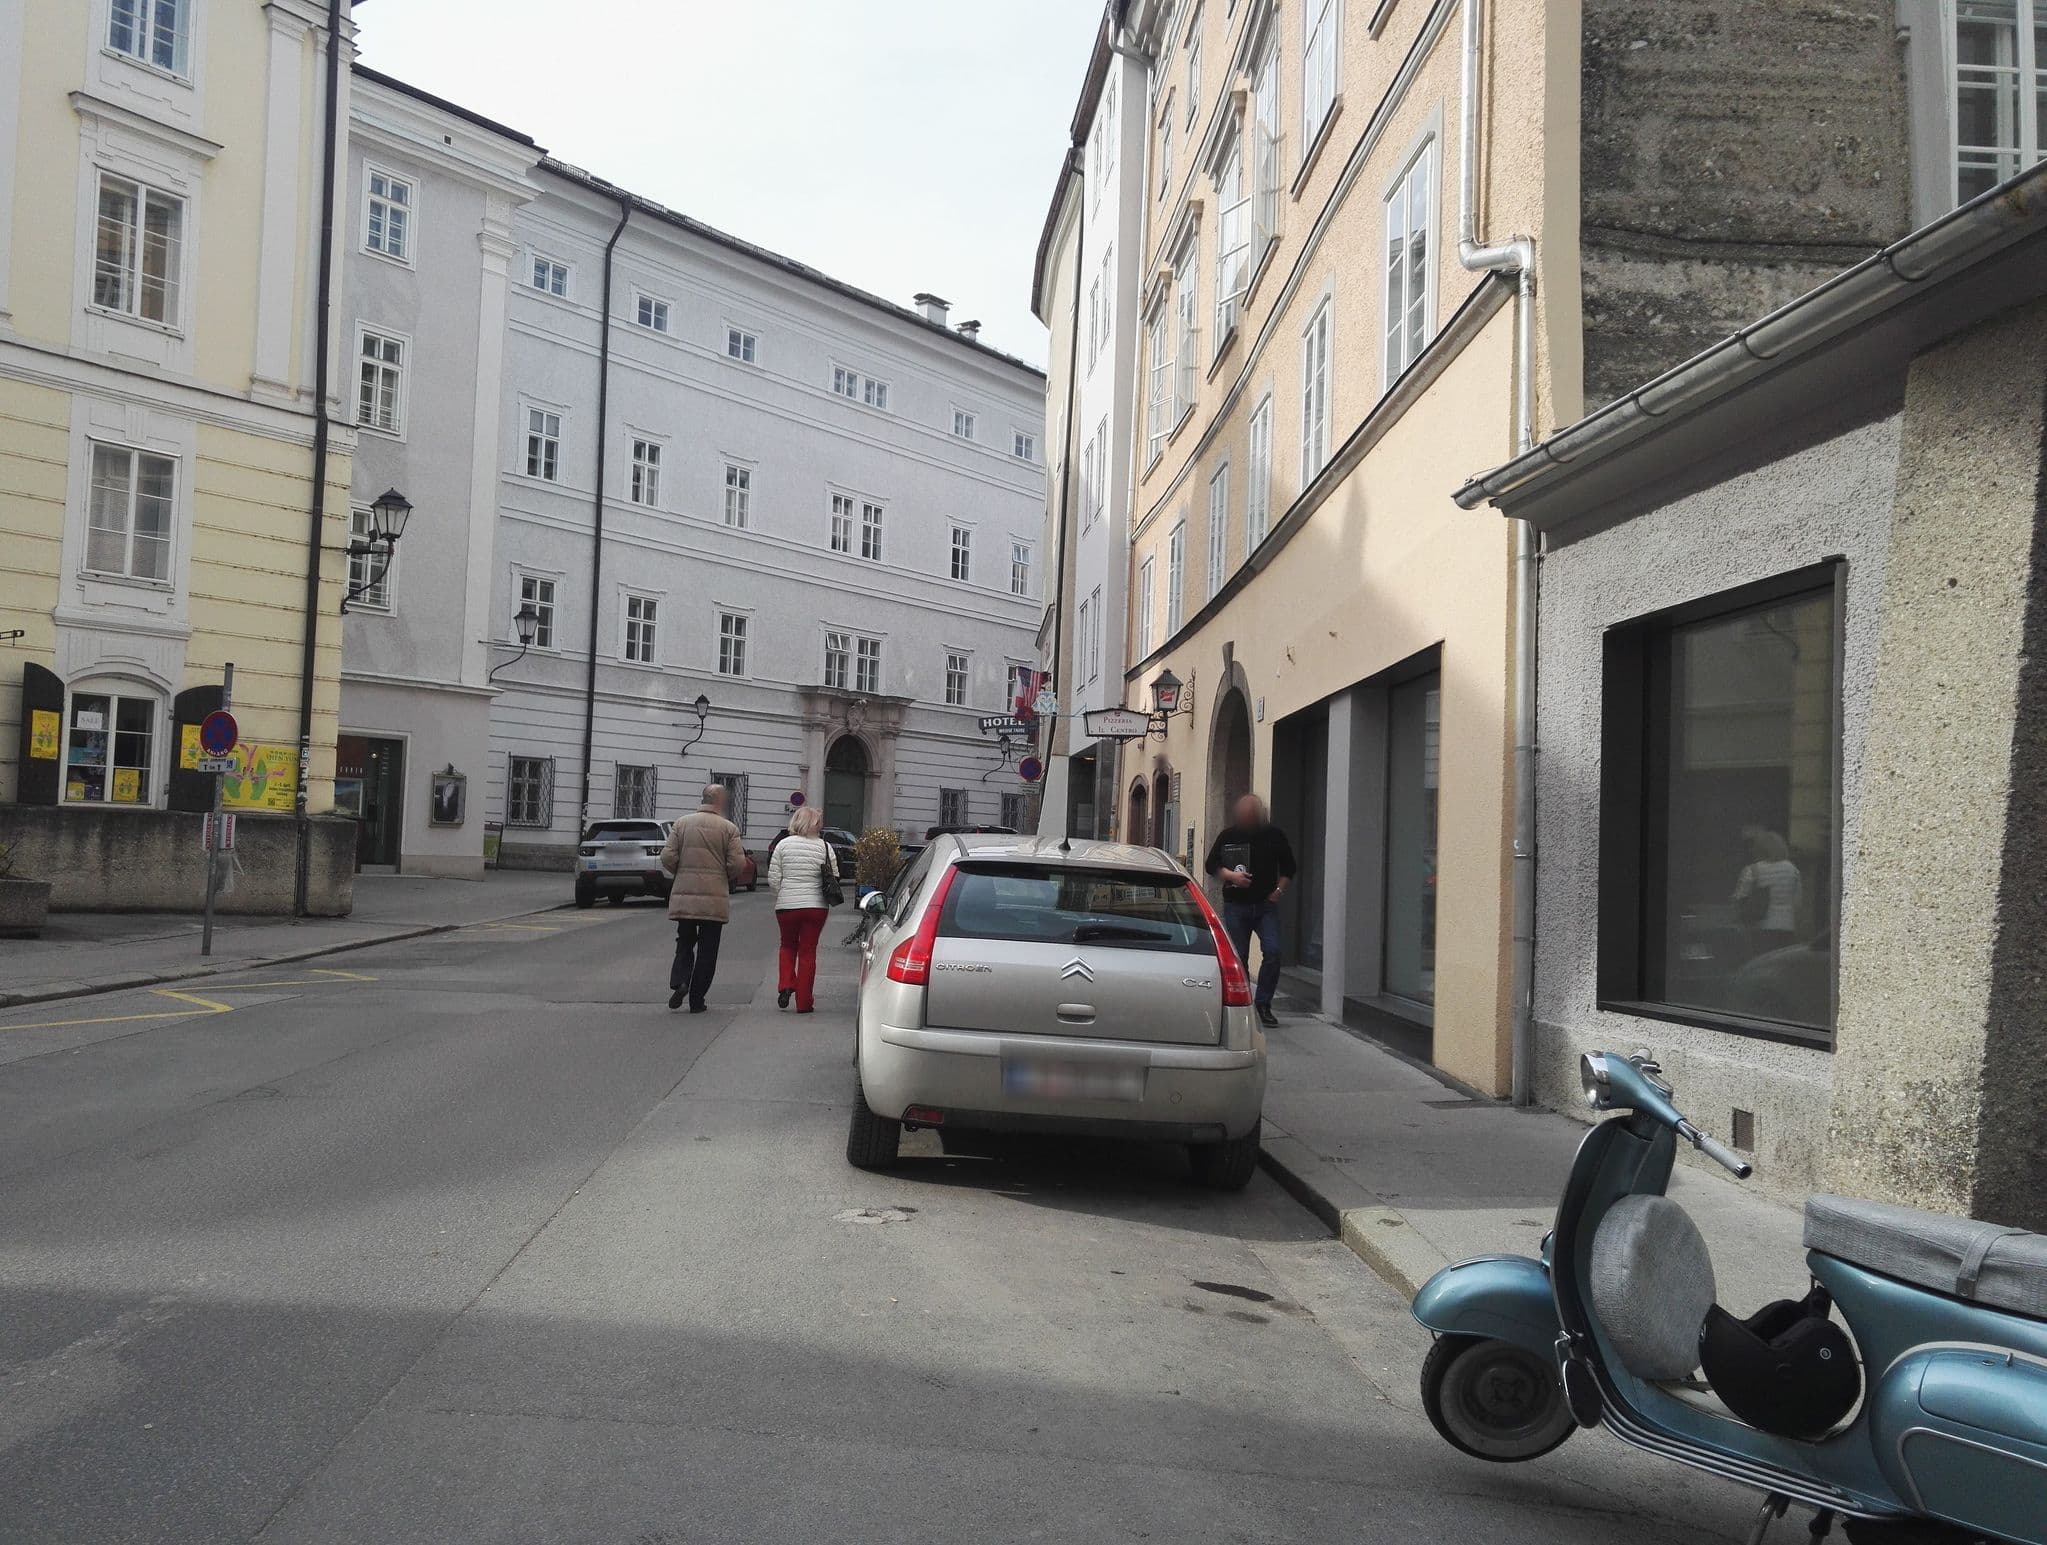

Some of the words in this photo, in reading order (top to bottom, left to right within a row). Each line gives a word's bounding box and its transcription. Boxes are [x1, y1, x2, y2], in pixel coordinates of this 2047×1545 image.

[983, 717, 1025, 727] HOTEL
[1103, 716, 1133, 724] PIZZERIA
[935, 962, 993, 973] CITROËN
[1181, 977, 1212, 989] C4
